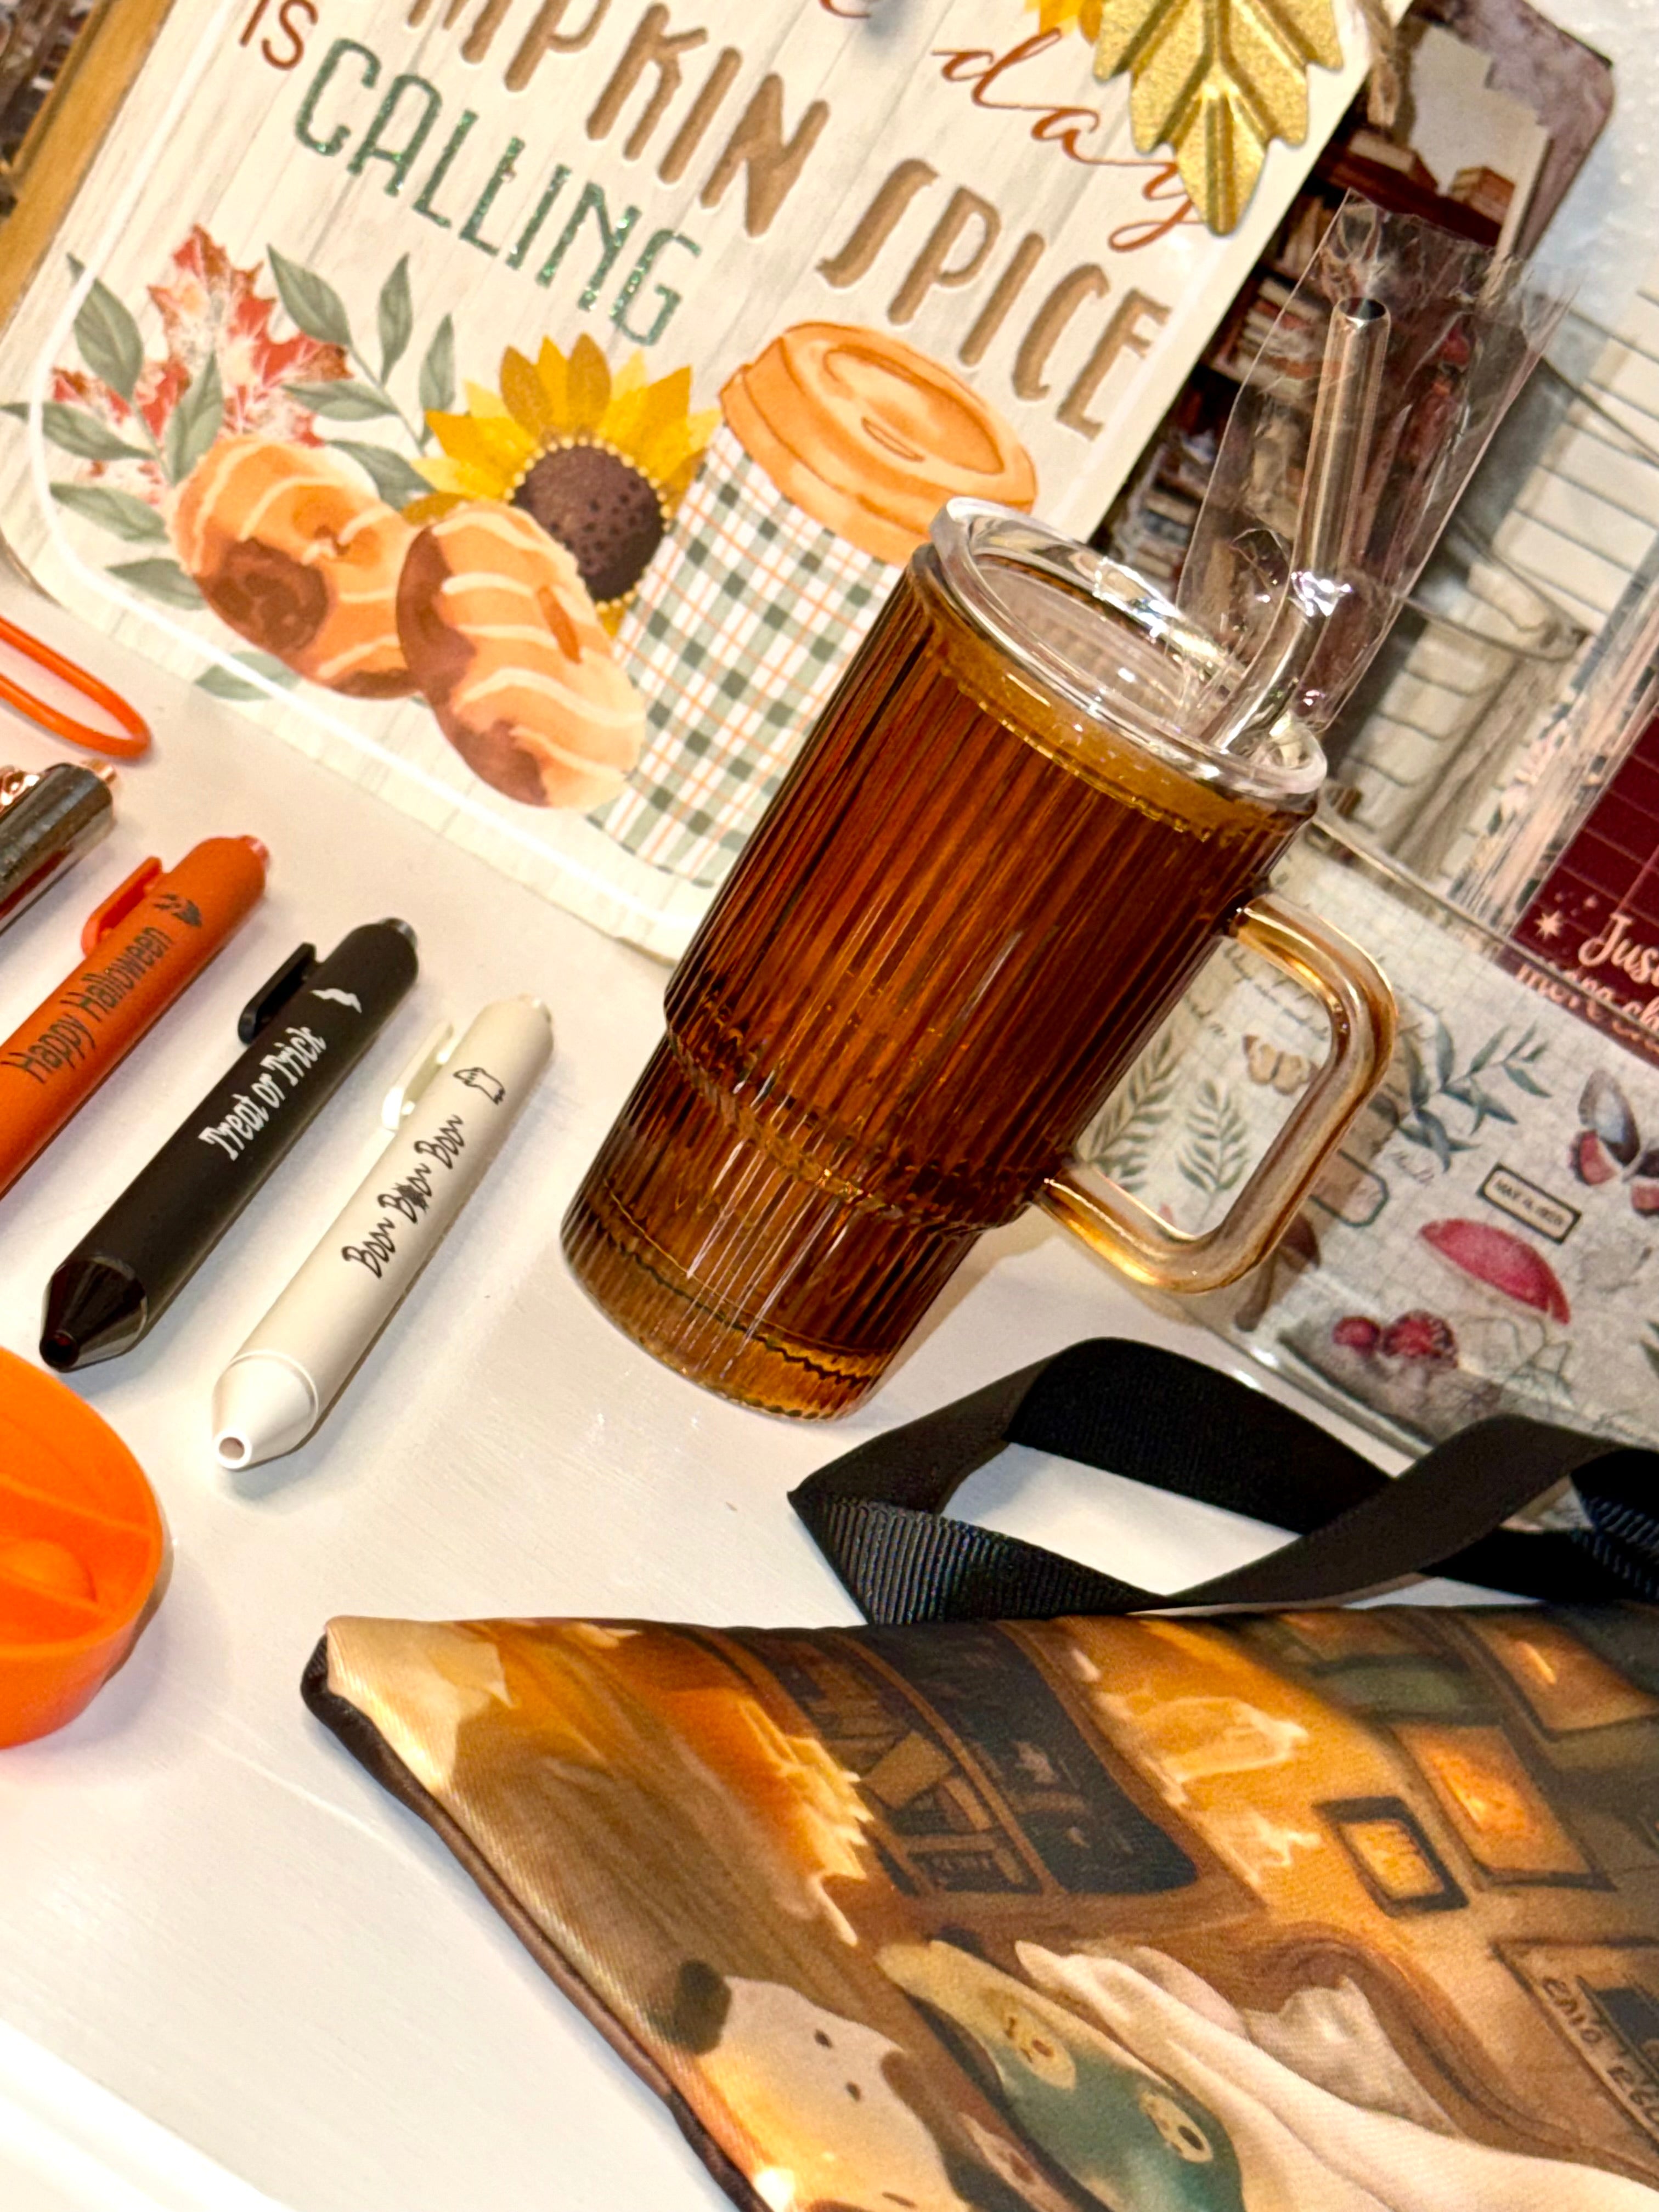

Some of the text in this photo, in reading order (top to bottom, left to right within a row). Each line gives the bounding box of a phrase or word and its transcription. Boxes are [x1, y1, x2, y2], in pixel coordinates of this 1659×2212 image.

[239, 0, 319, 71] IS
[295, 38, 701, 346] CALLING
[816, 157, 1172, 441] SPICE
[0, 927, 174, 1085] Happy Halloween
[198, 1026, 326, 1161] Treat or Trick
